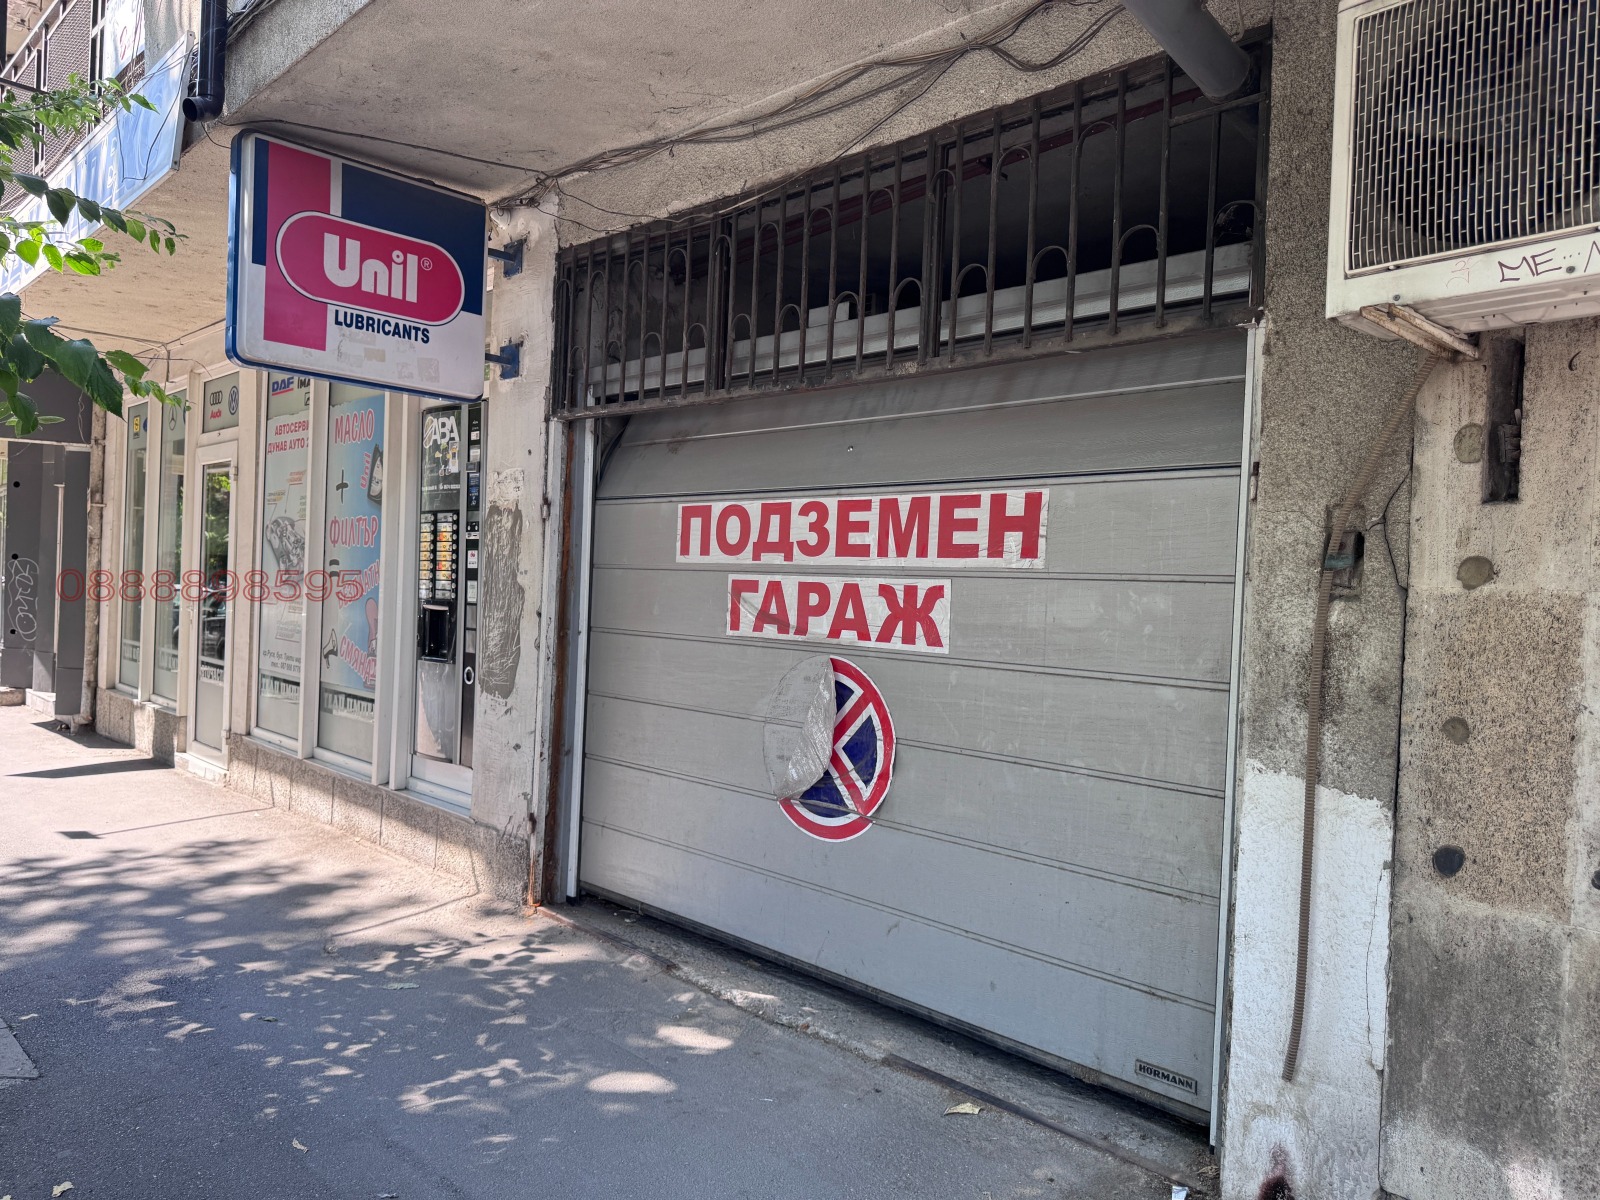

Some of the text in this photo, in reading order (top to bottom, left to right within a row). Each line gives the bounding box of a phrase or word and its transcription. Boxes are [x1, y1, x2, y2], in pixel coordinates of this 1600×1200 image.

[334, 309, 430, 344] LUBRICANTS
[271, 376, 294, 392] DAF
[210, 409, 222, 420] Audi
[334, 408, 375, 444] МАСЛО
[267, 441, 287, 455] ДУНАВ
[288, 437, 305, 451] АУТО
[360, 452, 371, 490] Unil
[329, 515, 379, 548] ФИЛТЪР
[679, 491, 1043, 562] ПОДЗЕМЕН
[729, 579, 945, 647] ГАРАЖ
